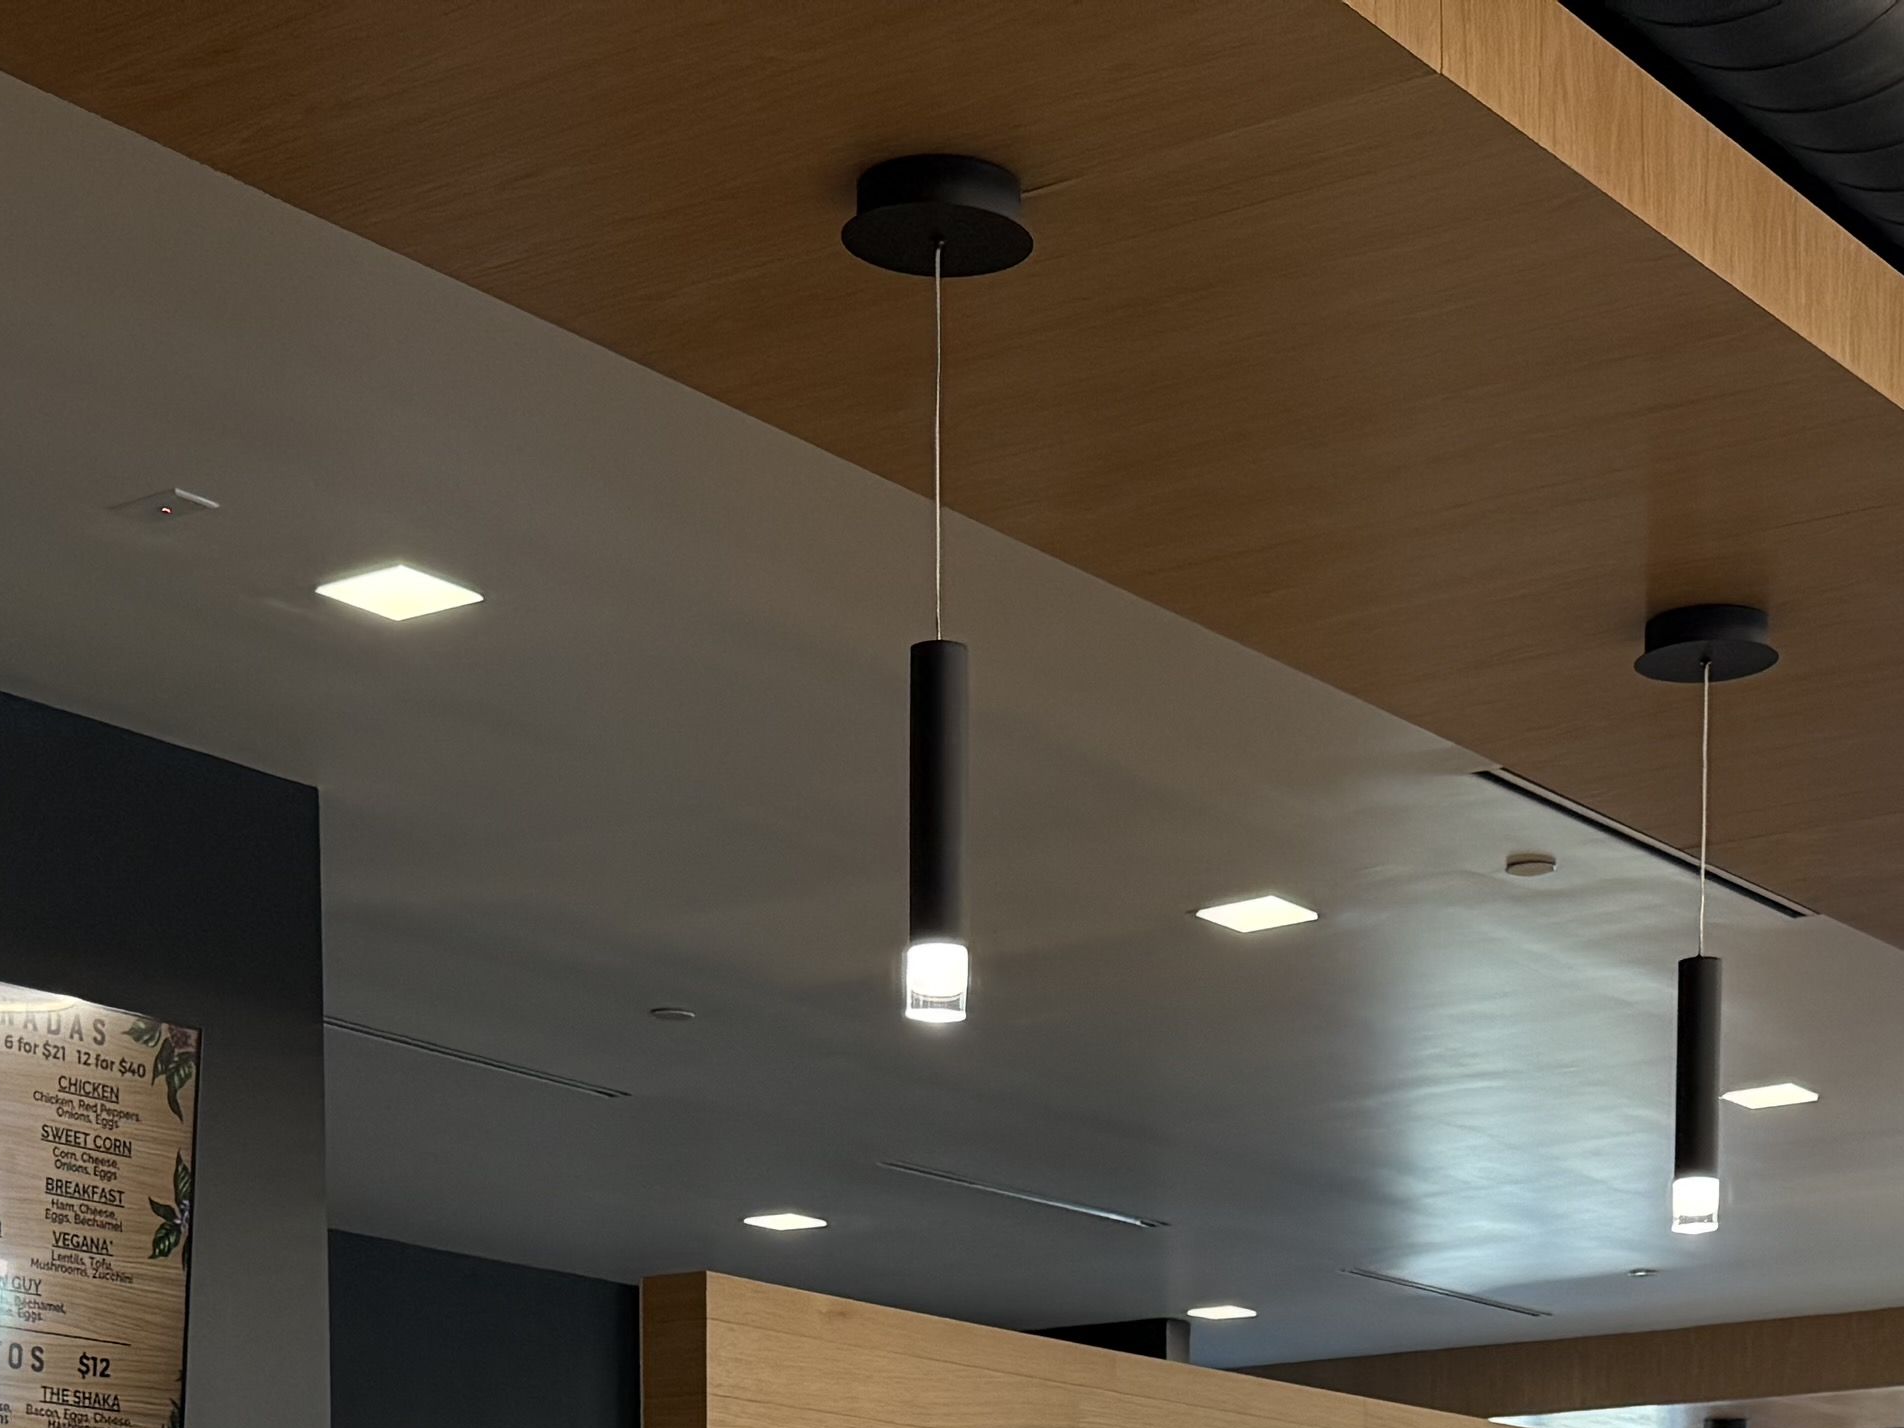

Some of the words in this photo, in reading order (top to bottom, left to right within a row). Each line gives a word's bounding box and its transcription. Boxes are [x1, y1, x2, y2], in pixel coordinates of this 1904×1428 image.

[4, 1035, 13, 1048] 6
[17, 1037, 37, 1055] for
[42, 1040, 66, 1061] $21
[76, 1049, 91, 1065] 12
[95, 1053, 115, 1071] for
[119, 1057, 146, 1079] $40
[58, 1076, 120, 1101] CHICKEN
[41, 1124, 90, 1147] SWEET
[93, 1135, 132, 1156] CORN
[46, 1178, 125, 1205] BREAKFAST
[12, 1276, 42, 1294] GUY
[77, 1351, 111, 1380] $12
[41, 1386, 70, 1405] THE
[72, 1389, 120, 1410] SHAKA
